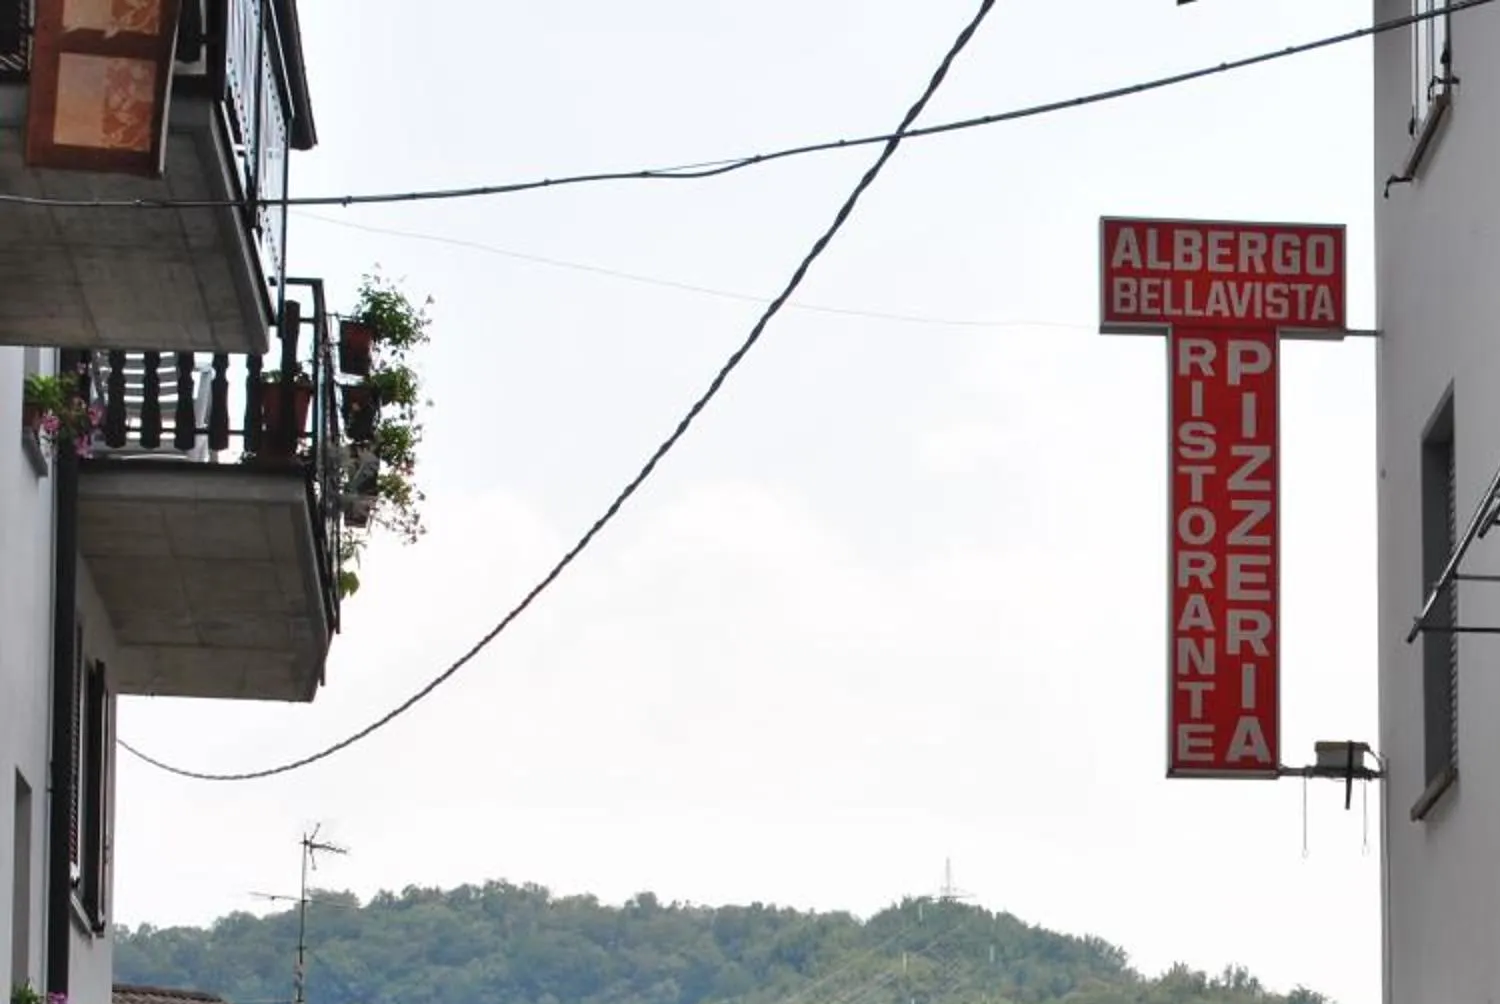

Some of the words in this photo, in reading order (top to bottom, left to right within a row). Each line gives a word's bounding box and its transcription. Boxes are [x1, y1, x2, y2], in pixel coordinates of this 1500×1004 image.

[1111, 227, 1335, 276] ALBERGO
[1112, 277, 1335, 321] BELLAVISTA
[1177, 338, 1217, 762] RISTORANTE
[1226, 340, 1272, 764] PIZZERIA
